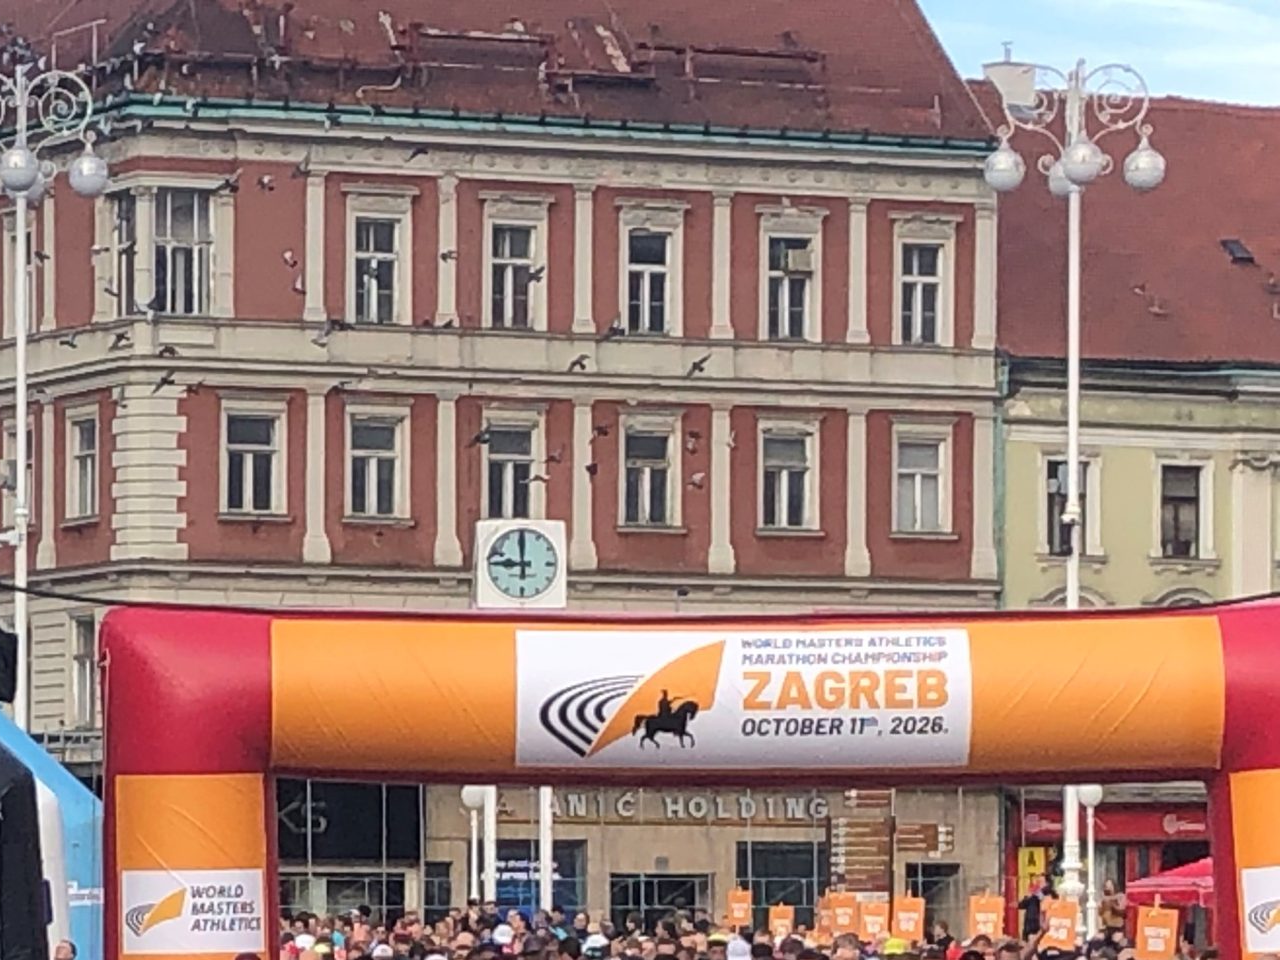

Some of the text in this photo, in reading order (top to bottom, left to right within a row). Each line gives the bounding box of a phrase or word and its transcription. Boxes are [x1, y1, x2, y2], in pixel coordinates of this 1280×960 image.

[741, 636, 947, 649] WORLD MASTERS ATHLETICS
[741, 651, 948, 665] MARATHON CHAMPIONSHIP
[742, 669, 949, 711] ZAGREB
[741, 717, 843, 737] OCTOBER
[663, 796, 830, 819] HOLDING
[190, 884, 244, 899] WORLD
[190, 901, 255, 916] MASTERS
[190, 916, 262, 932] ATHLETICS
